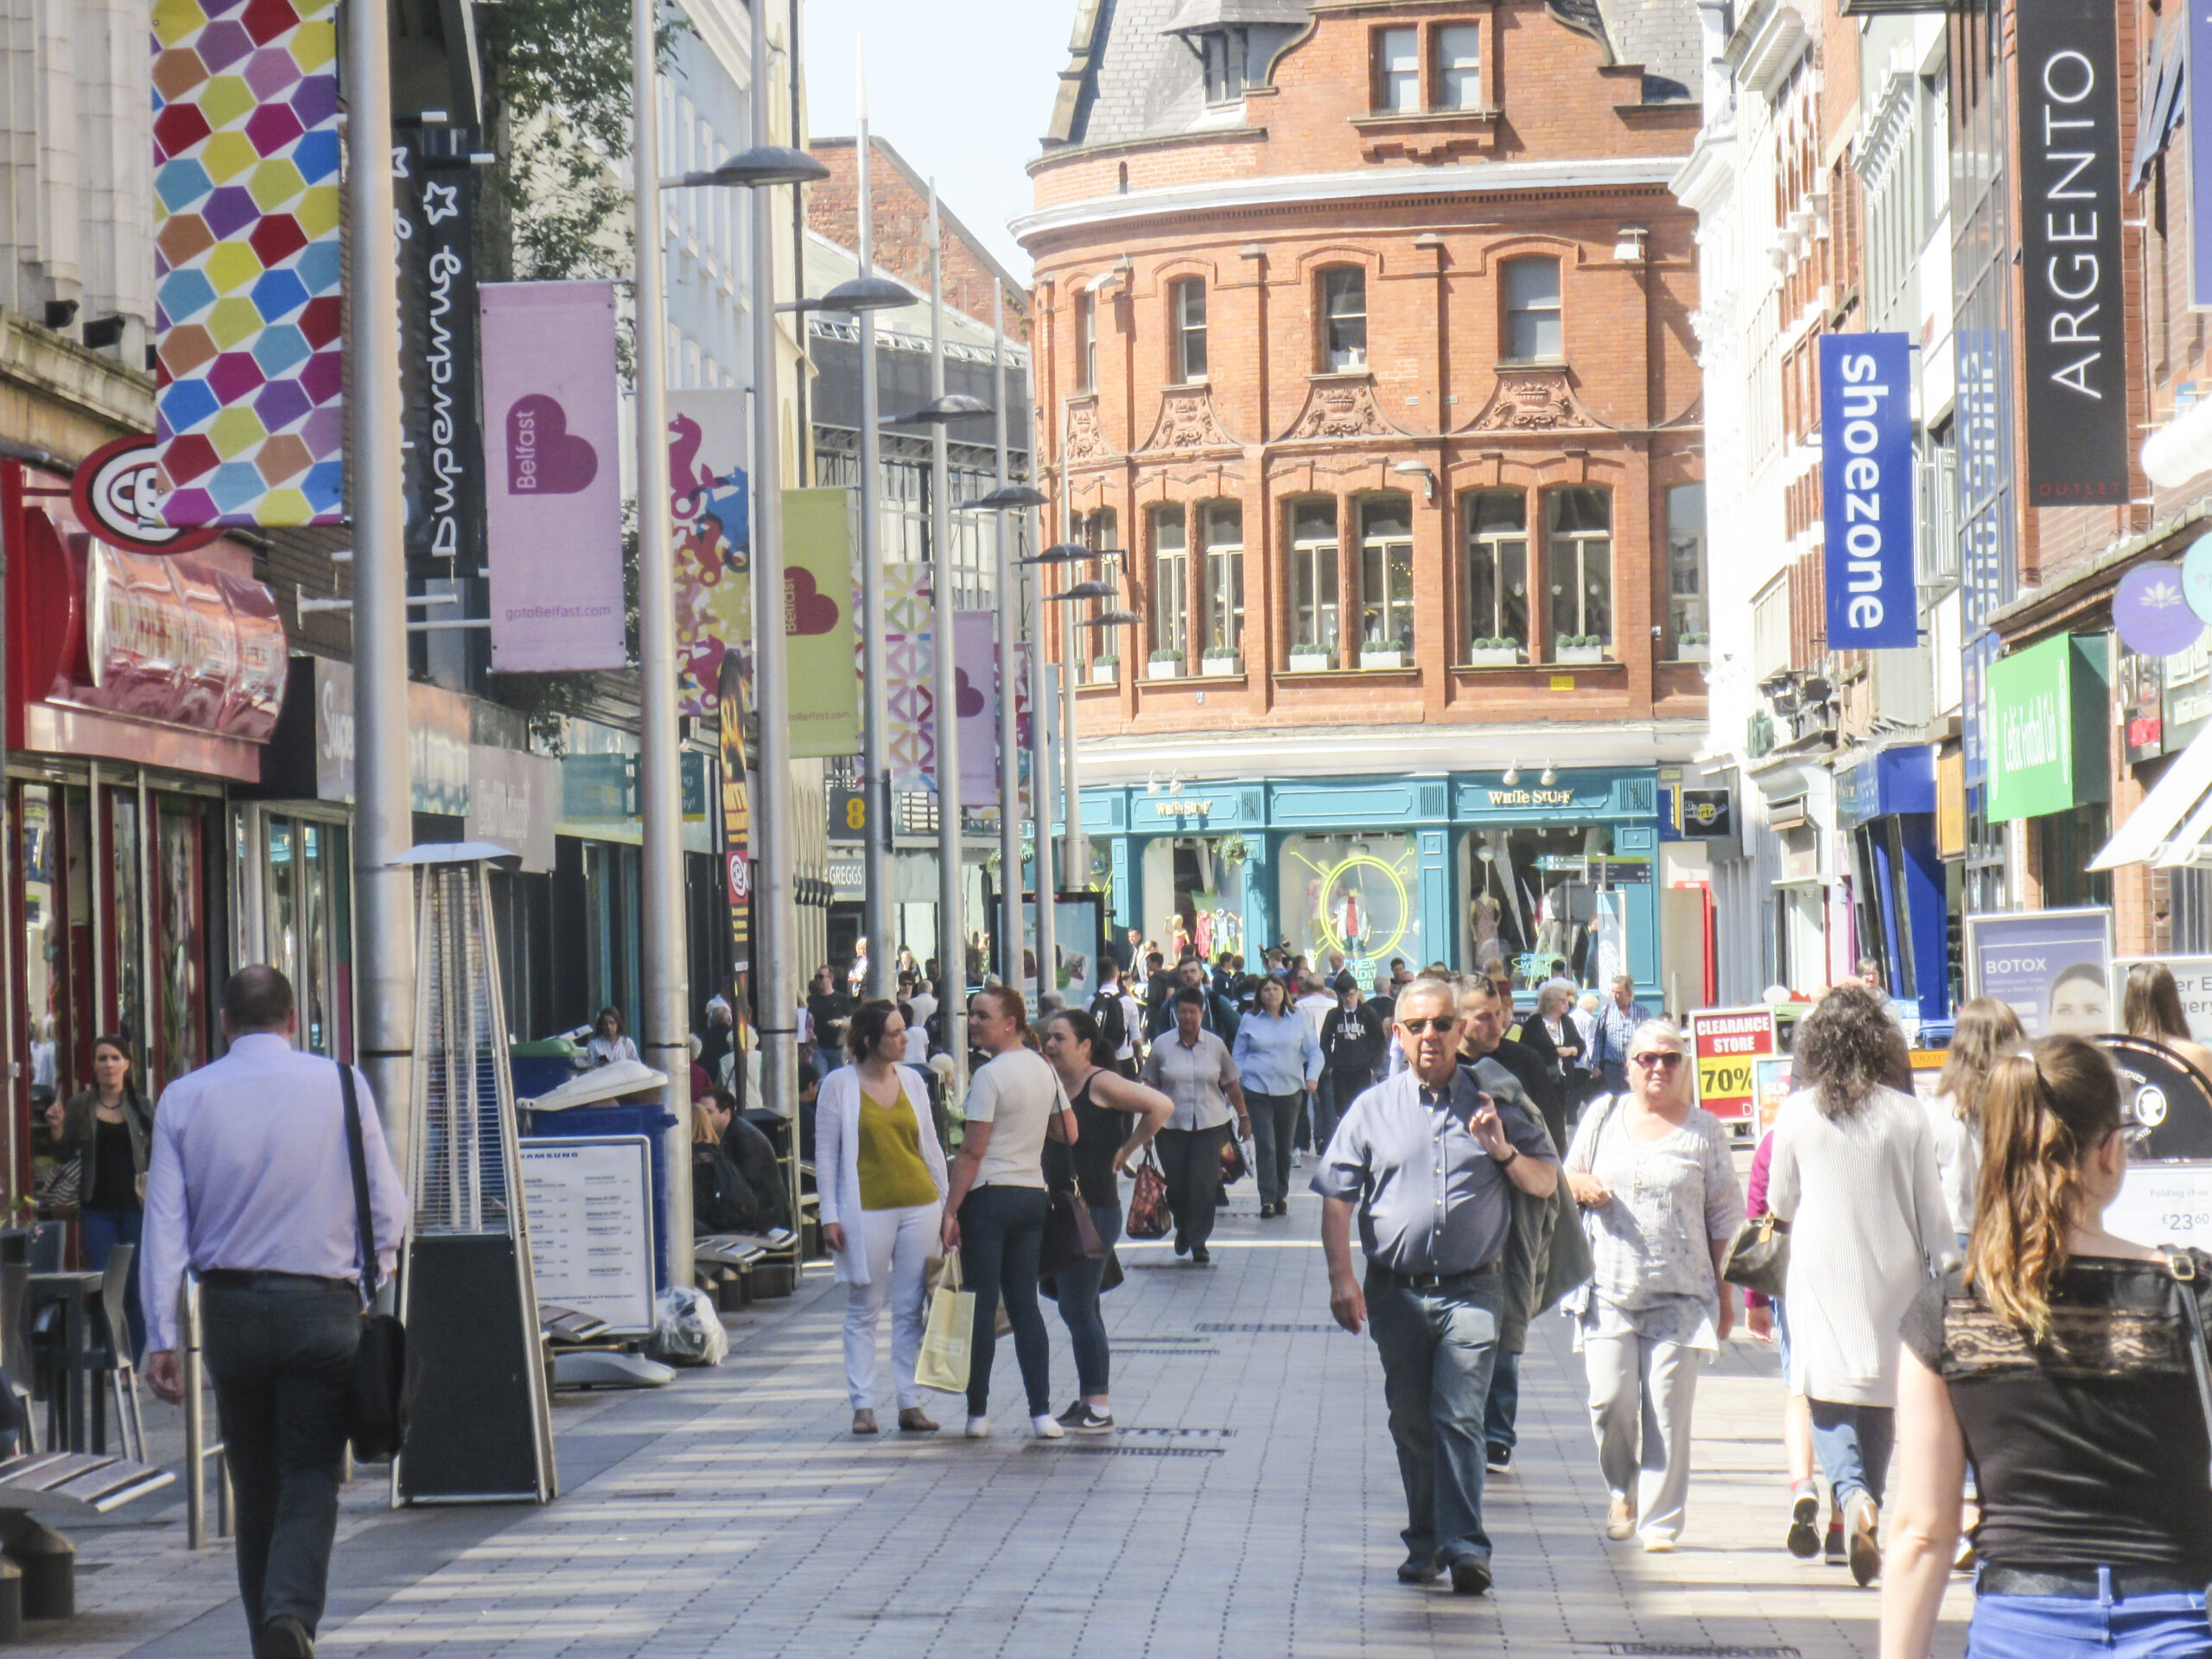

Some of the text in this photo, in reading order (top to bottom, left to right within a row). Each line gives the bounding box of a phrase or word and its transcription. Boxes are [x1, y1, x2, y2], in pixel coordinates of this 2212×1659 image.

[2044, 50, 2102, 399] ARGENTO
[516, 410, 537, 489] Belfast
[1842, 354, 1890, 629] shoezone
[2038, 481, 2120, 497] OUTLET
[505, 605, 611, 621] gotoBelfast.com
[830, 865, 862, 885] GREGGS
[1986, 957, 2046, 974] BOTOX
[1696, 1017, 1770, 1036] CLEARANCE
[1713, 1035, 1756, 1053] STORE
[1701, 1067, 1752, 1093] 70%
[2150, 1188, 2184, 1198] Folding
